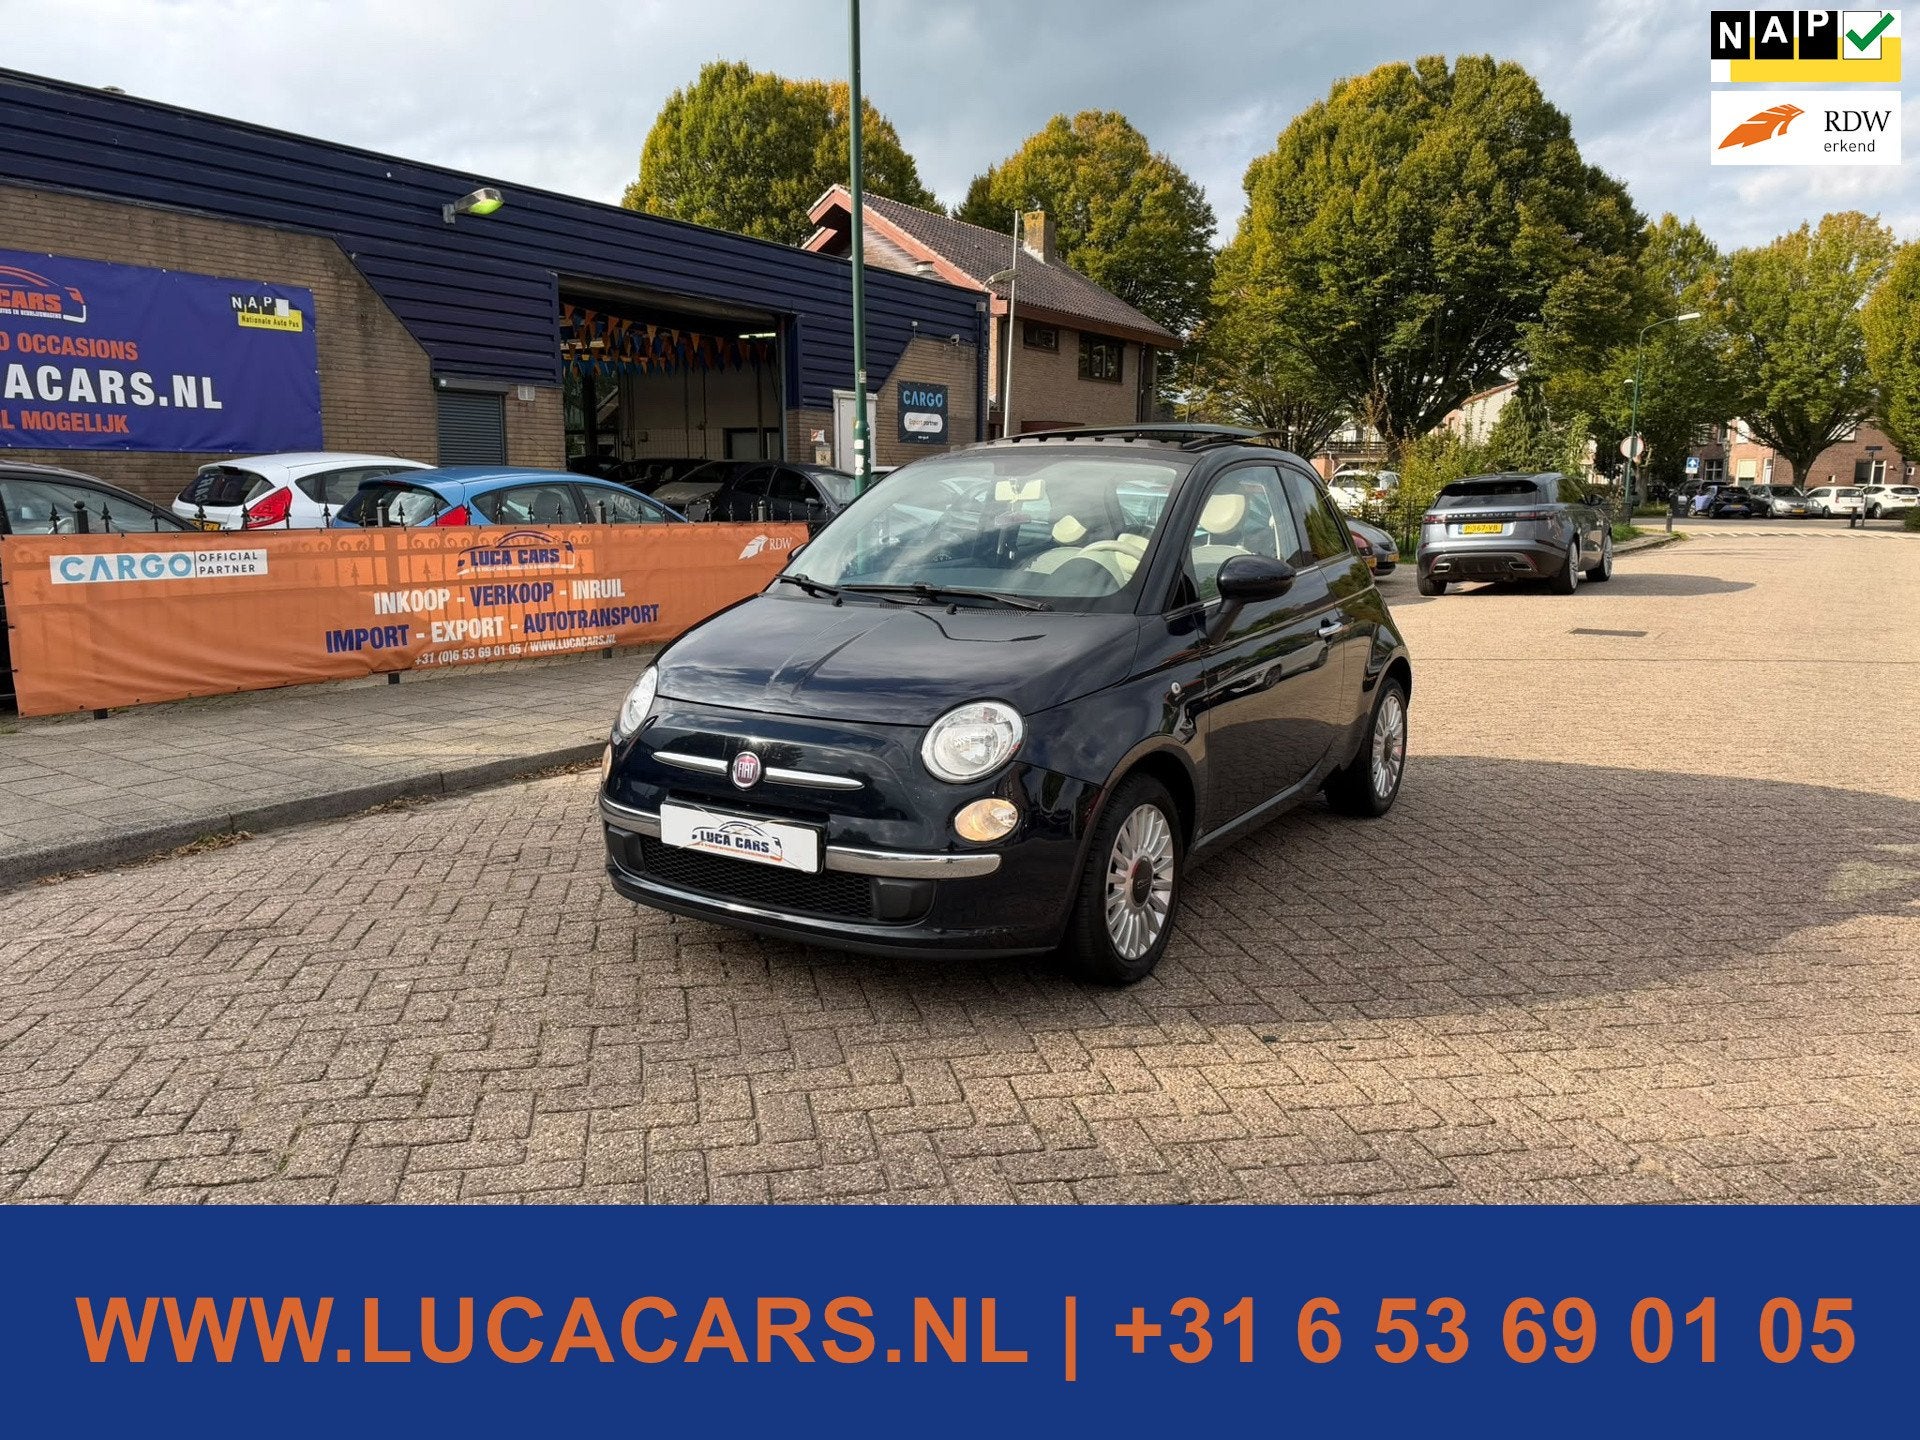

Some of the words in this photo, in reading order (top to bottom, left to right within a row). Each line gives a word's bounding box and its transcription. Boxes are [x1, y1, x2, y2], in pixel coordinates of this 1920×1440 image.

[231, 296, 272, 309] NAP
[241, 315, 271, 325] Nationale
[273, 318, 287, 327] Auto
[17, 331, 139, 361] OCCASIONS
[4, 363, 223, 410] ACARS.NL
[903, 390, 943, 408] CARGO
[20, 410, 130, 434] MOGELIJK
[769, 537, 793, 550] RDW
[59, 553, 192, 582] CARGO
[199, 551, 258, 563] OFFICIAL
[470, 549, 512, 567] LUCA
[517, 548, 560, 565] CARS
[199, 564, 256, 575] PARTNER
[373, 588, 450, 615] INKOOP
[469, 582, 554, 607] VERKOOP
[572, 579, 626, 600] INRUIL
[325, 624, 410, 653] IMPORT
[430, 616, 504, 643] EXPORT
[523, 603, 660, 634] AUTOTRANSPORT
[414, 652, 434, 665] +31
[438, 649, 460, 664] (0)6
[462, 648, 476, 660] 53
[478, 646, 491, 658] 69
[493, 645, 505, 656] 01
[508, 643, 521, 655] 05
[530, 634, 617, 652] WWW.LUCACARS.NL
[737, 761, 756, 779] FIAT
[700, 830, 731, 846] LUCA
[735, 836, 769, 853] CARS
